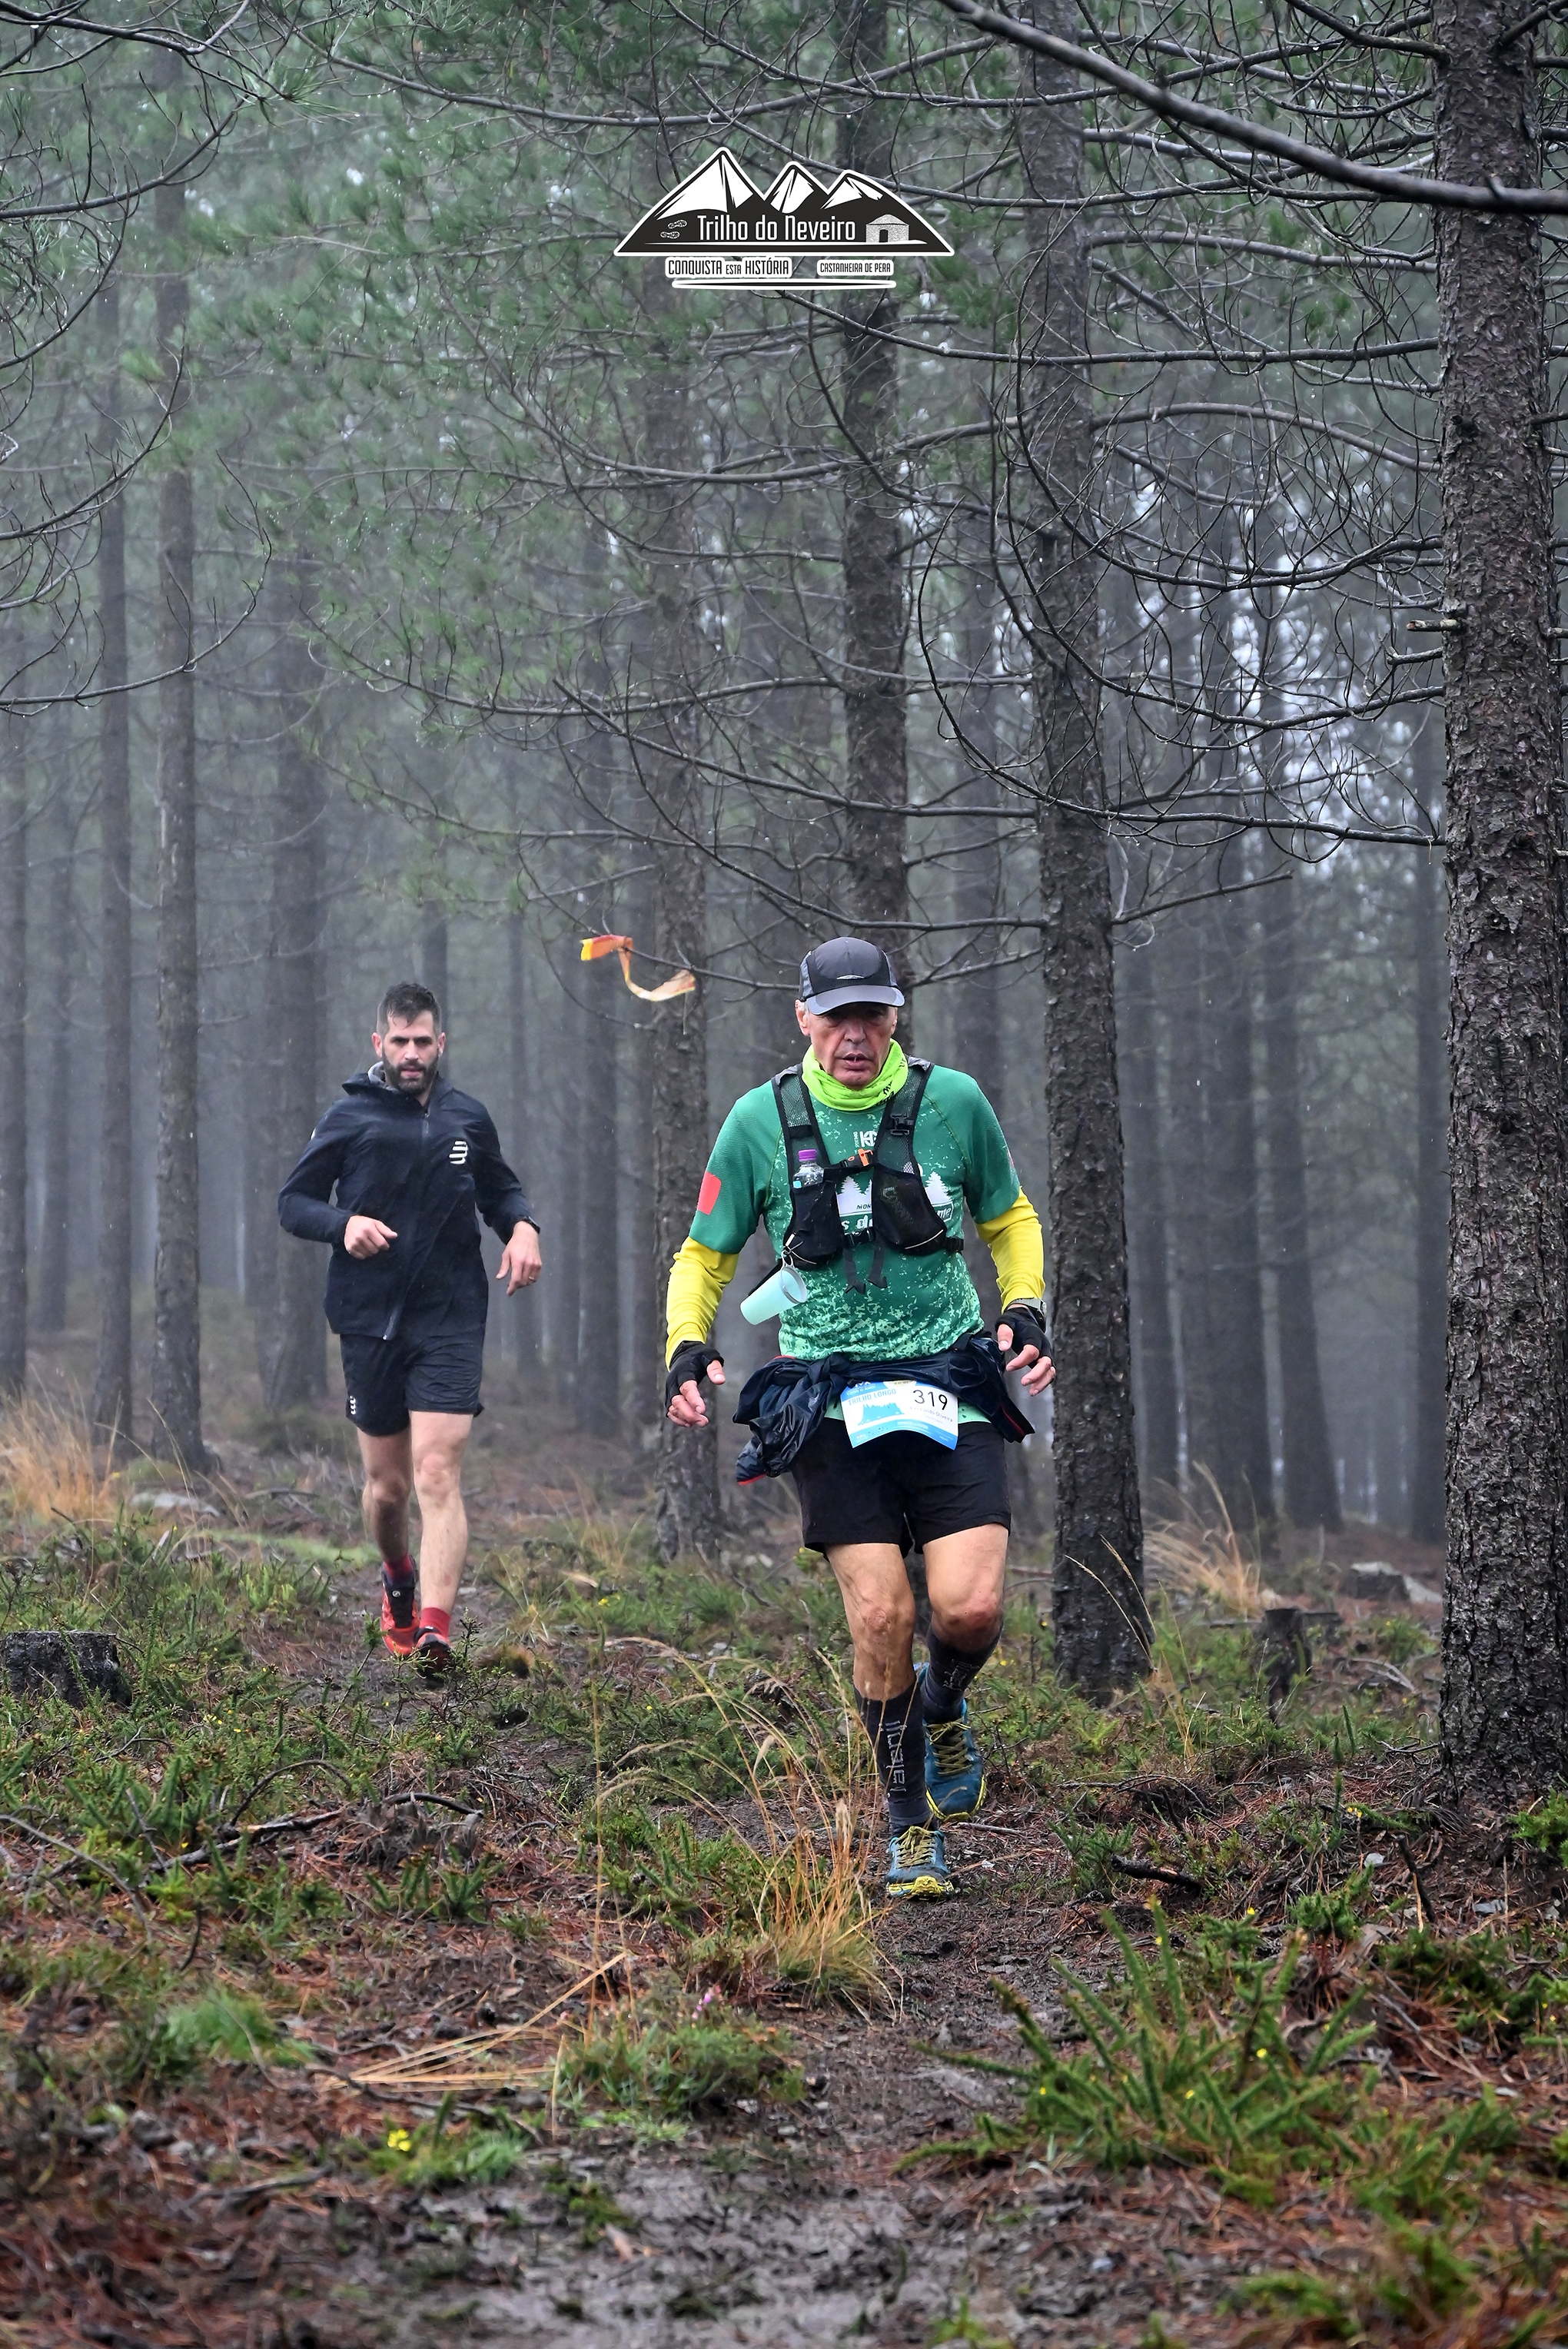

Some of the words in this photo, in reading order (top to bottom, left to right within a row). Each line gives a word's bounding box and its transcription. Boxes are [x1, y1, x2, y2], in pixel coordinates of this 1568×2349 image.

[848, 1394, 872, 1406] TRILHO
[873, 1388, 897, 1398] LONGO
[912, 1389, 948, 1410] 319
